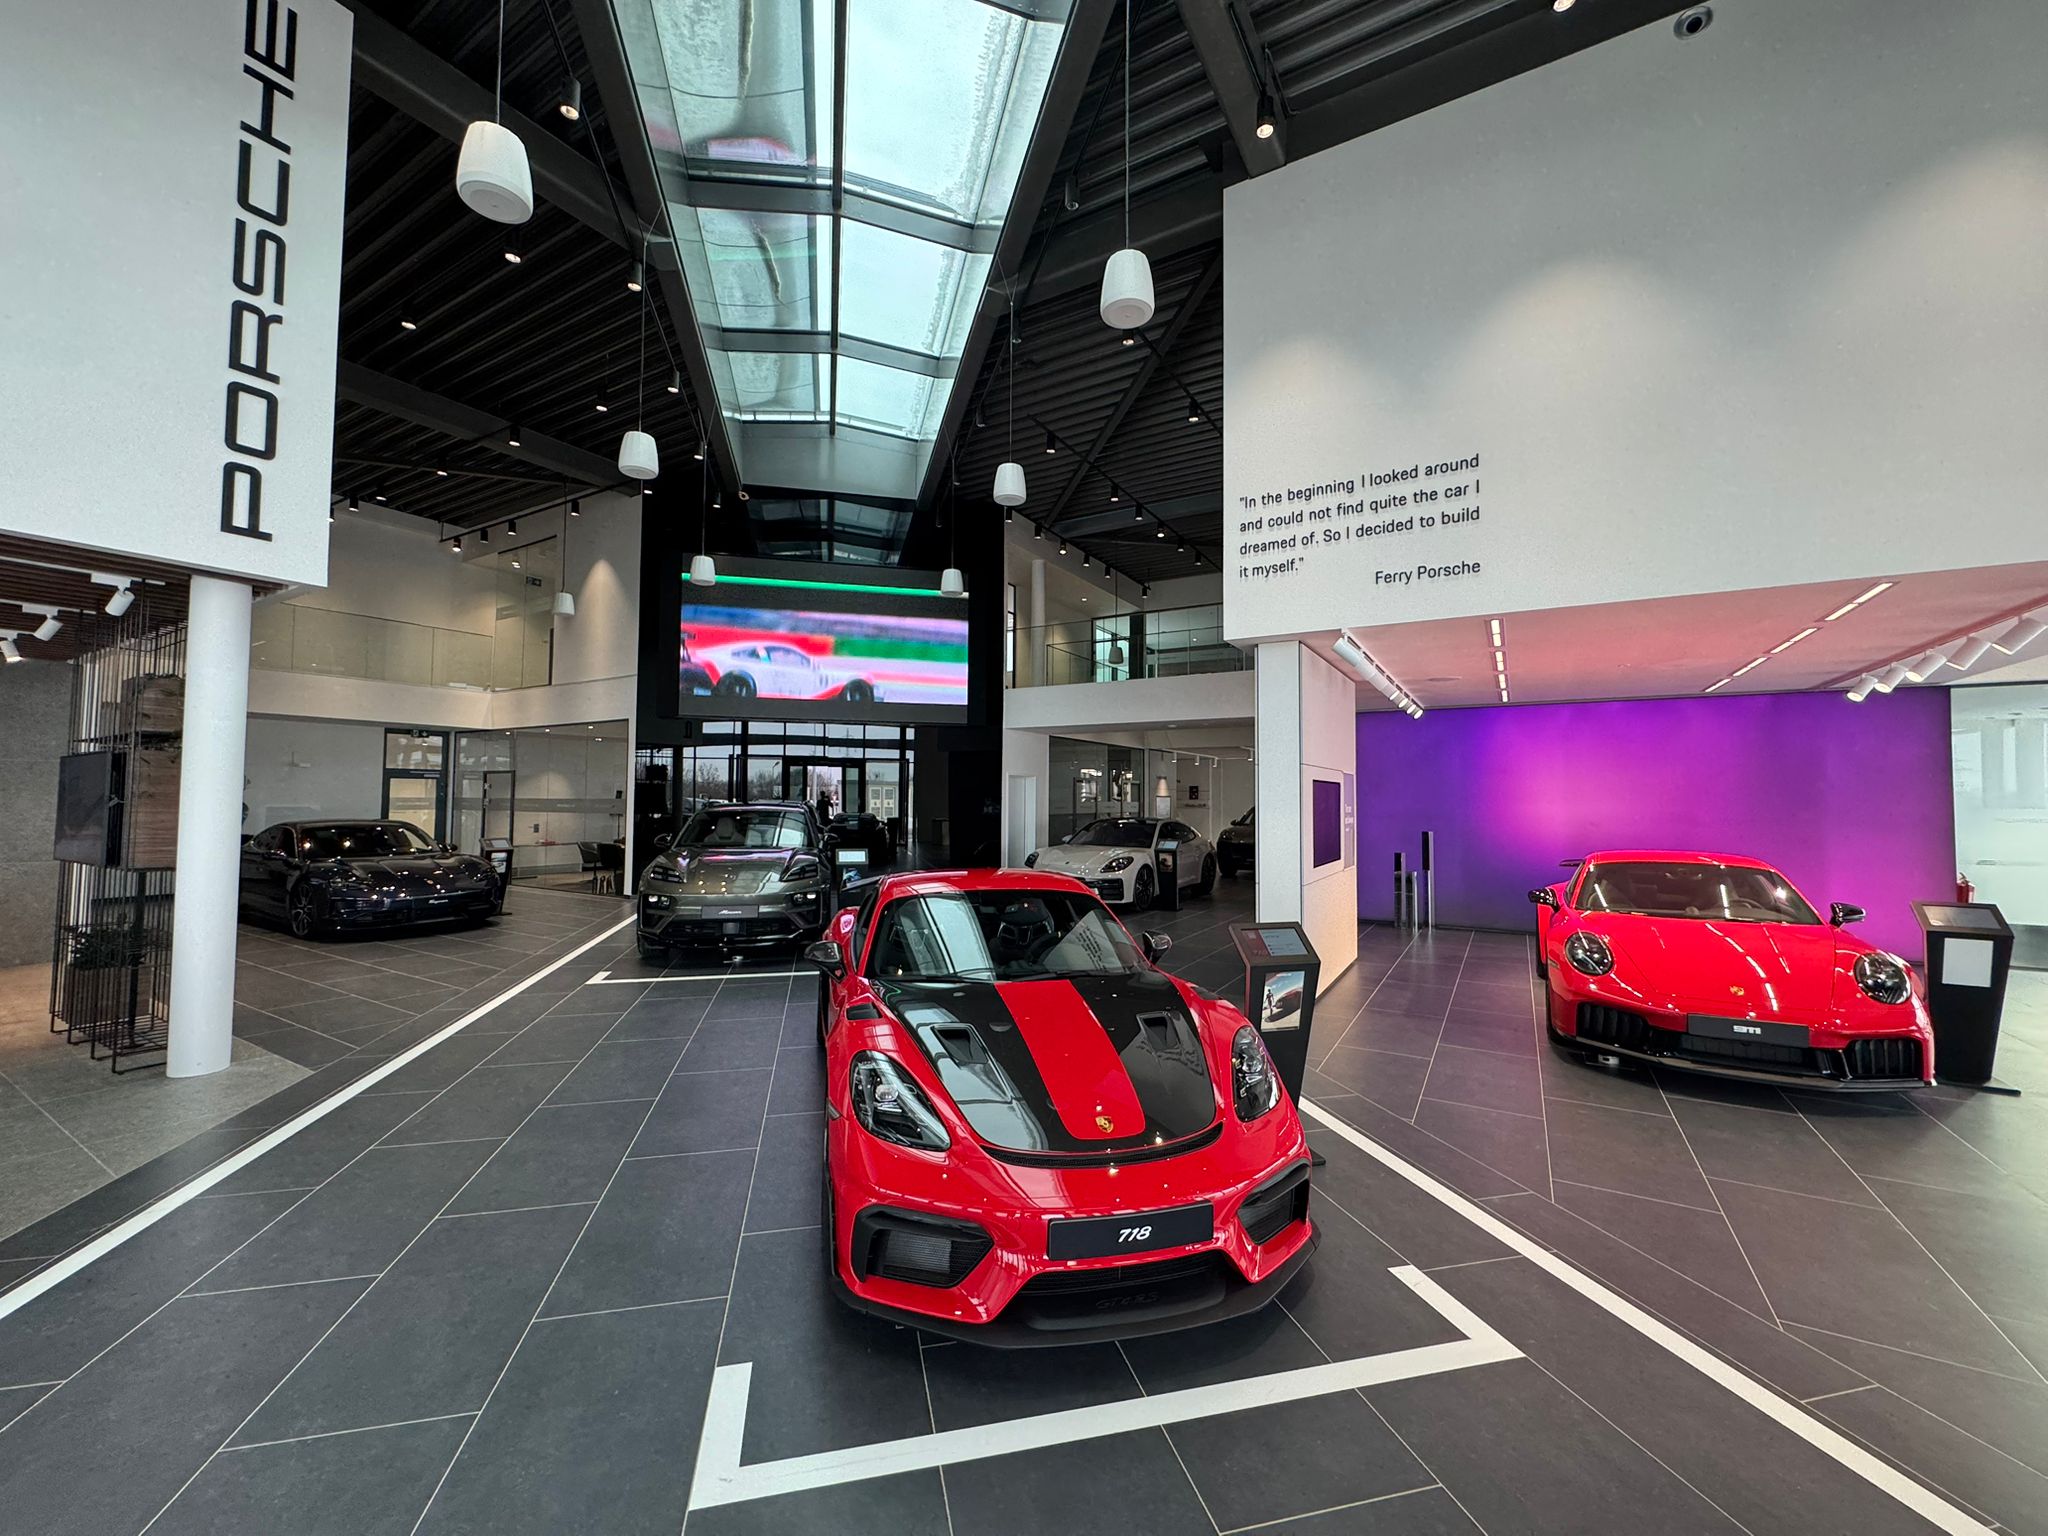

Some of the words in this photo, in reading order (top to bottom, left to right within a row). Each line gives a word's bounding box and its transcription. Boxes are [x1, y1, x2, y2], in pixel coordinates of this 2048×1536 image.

[220, 0, 298, 542] PORSCHE
[1239, 496, 1257, 509] "In
[1261, 492, 1283, 506] the
[1287, 479, 1355, 502] beginning
[1369, 464, 1419, 487] looked
[1424, 453, 1479, 477] around
[1239, 517, 1263, 533] and
[1267, 510, 1304, 528] could
[1309, 506, 1332, 521] not
[1336, 499, 1364, 517] find
[1369, 494, 1408, 514] quite
[1413, 489, 1439, 504] the
[1444, 484, 1470, 499] car
[1239, 534, 1297, 556] dreamed
[1301, 531, 1320, 547] of.
[1323, 528, 1342, 543] So
[1355, 516, 1414, 538] decided
[1419, 515, 1436, 529] to
[1441, 506, 1481, 525] build
[1239, 565, 1249, 579] it
[1252, 556, 1305, 578] myself."
[1375, 570, 1414, 586] Ferry
[1417, 560, 1481, 580] Porsche
[1118, 1225, 1153, 1243] 718
